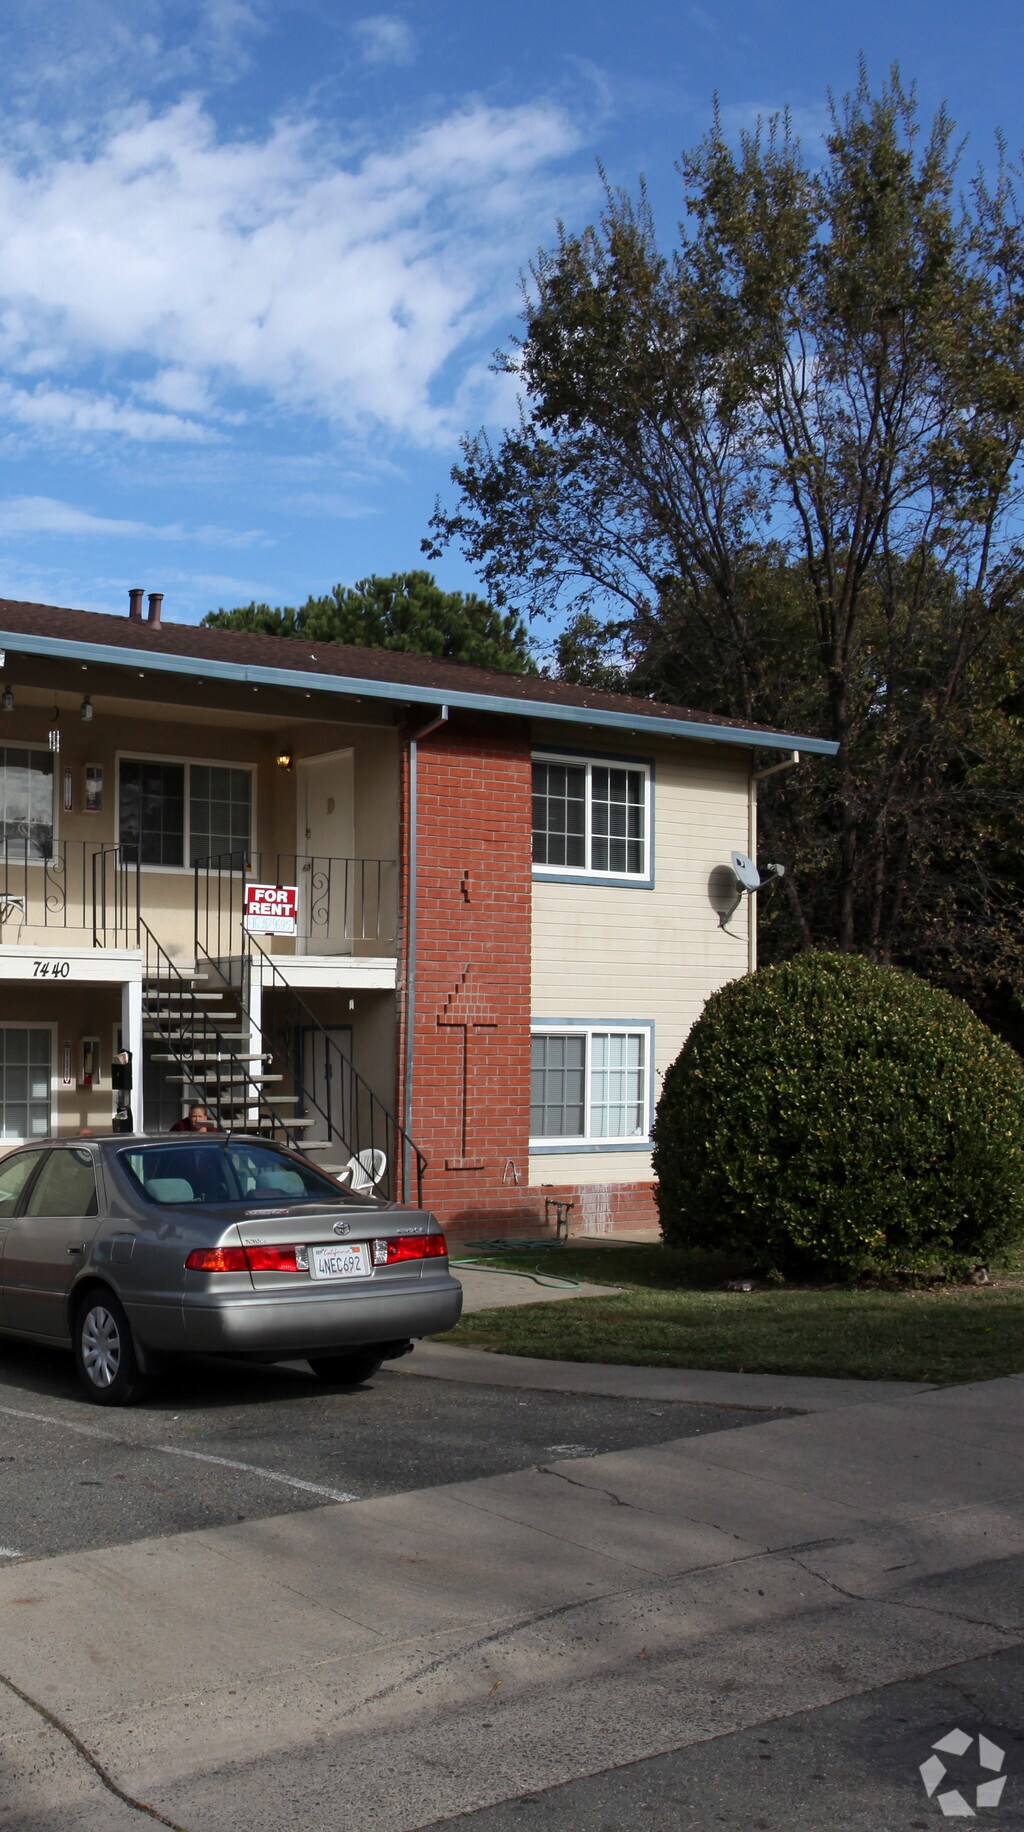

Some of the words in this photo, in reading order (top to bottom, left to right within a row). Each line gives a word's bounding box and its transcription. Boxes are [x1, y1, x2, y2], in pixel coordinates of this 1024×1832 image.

[254, 889, 288, 903] FOR
[248, 901, 294, 916] RENT
[32, 960, 71, 978] 7440
[322, 1247, 353, 1257] California
[318, 1255, 362, 1275] 4NEC692
